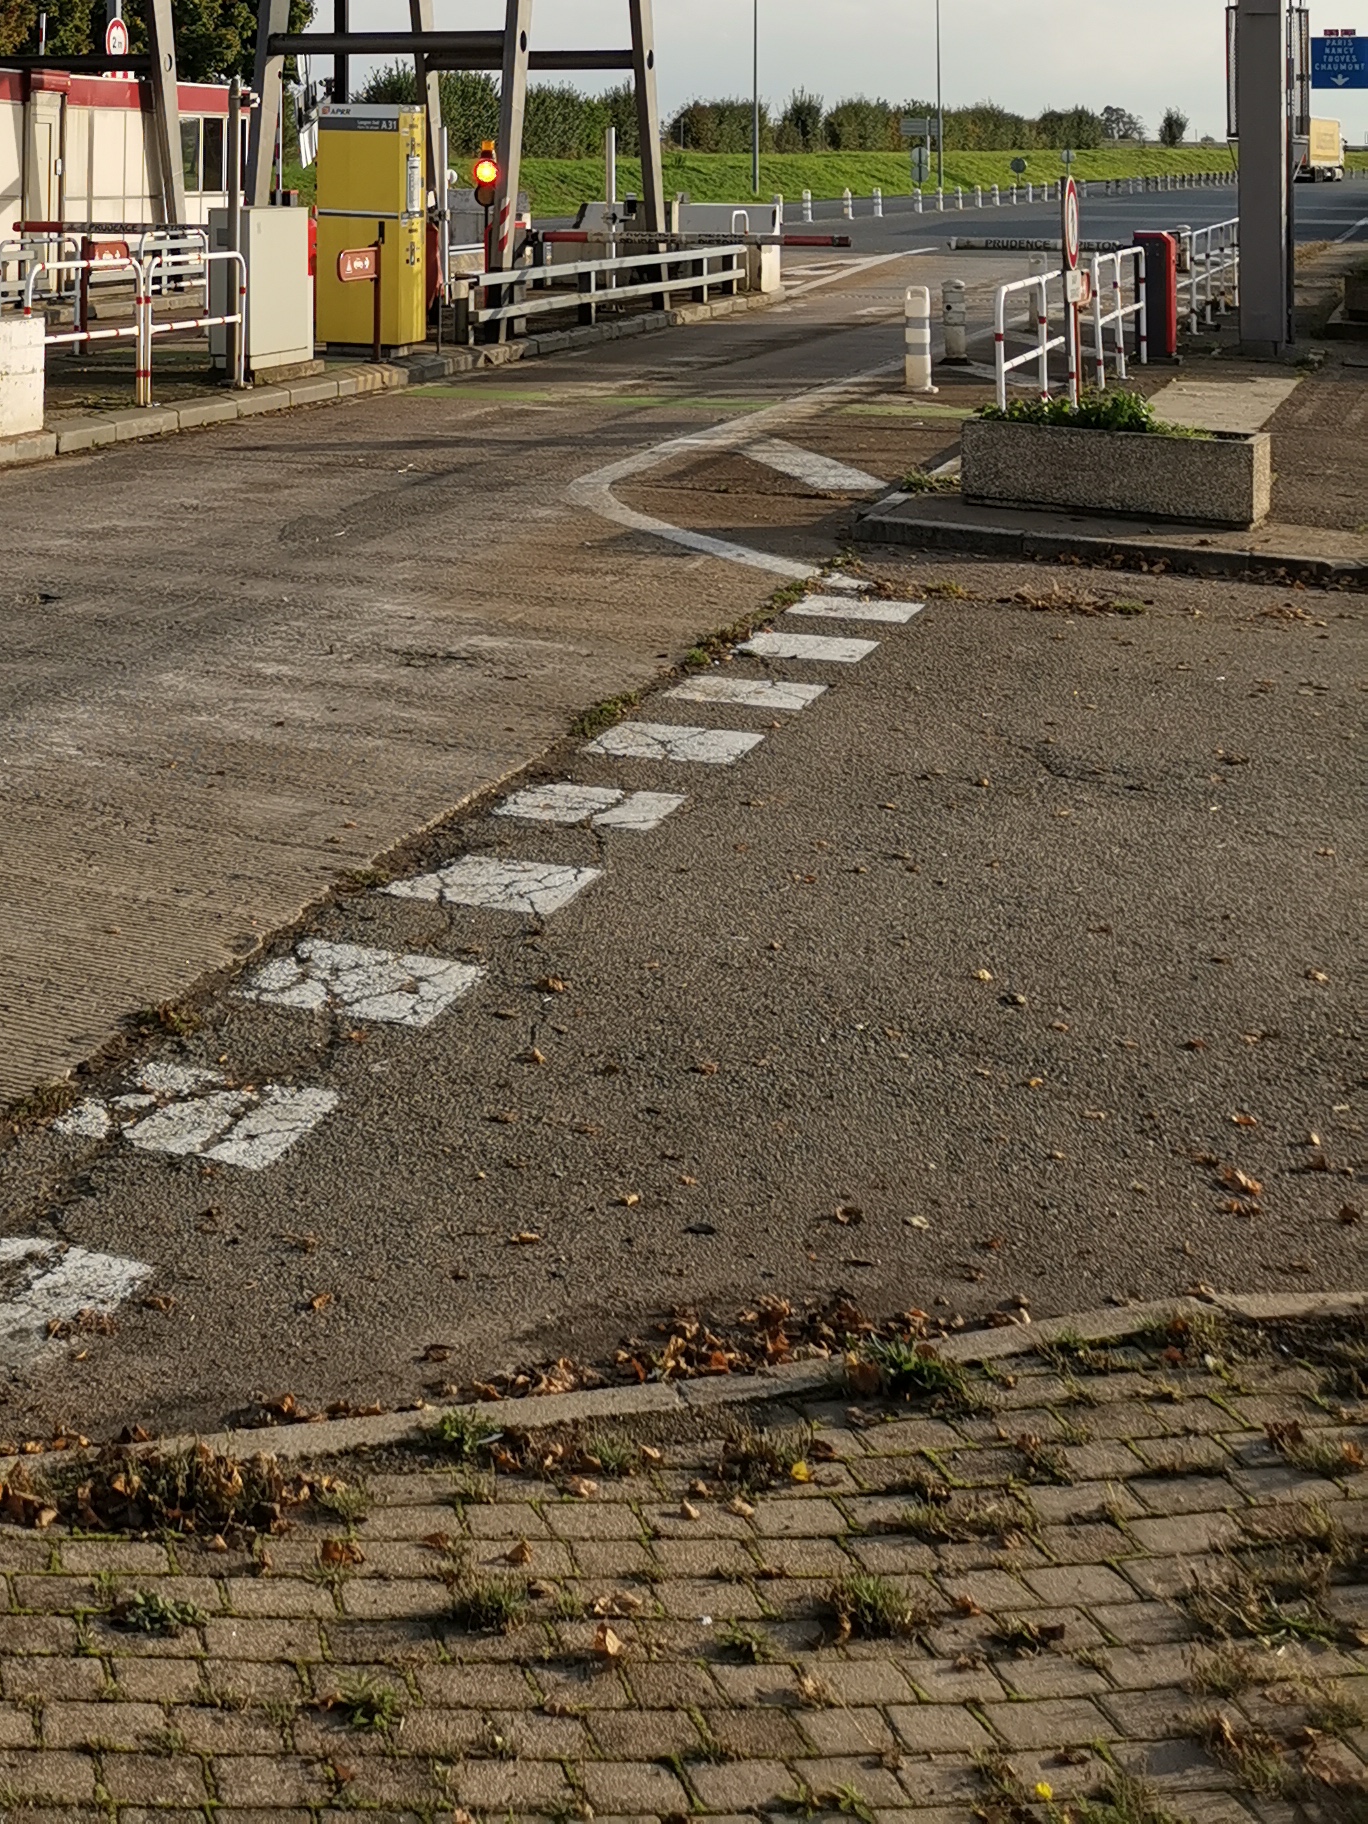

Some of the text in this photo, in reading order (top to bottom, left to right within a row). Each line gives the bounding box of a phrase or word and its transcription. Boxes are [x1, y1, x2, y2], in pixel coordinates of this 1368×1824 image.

[381, 120, 397, 130] A31
[88, 224, 137, 232] PRUDENCE
[985, 239, 1051, 250] PRUDENCE
